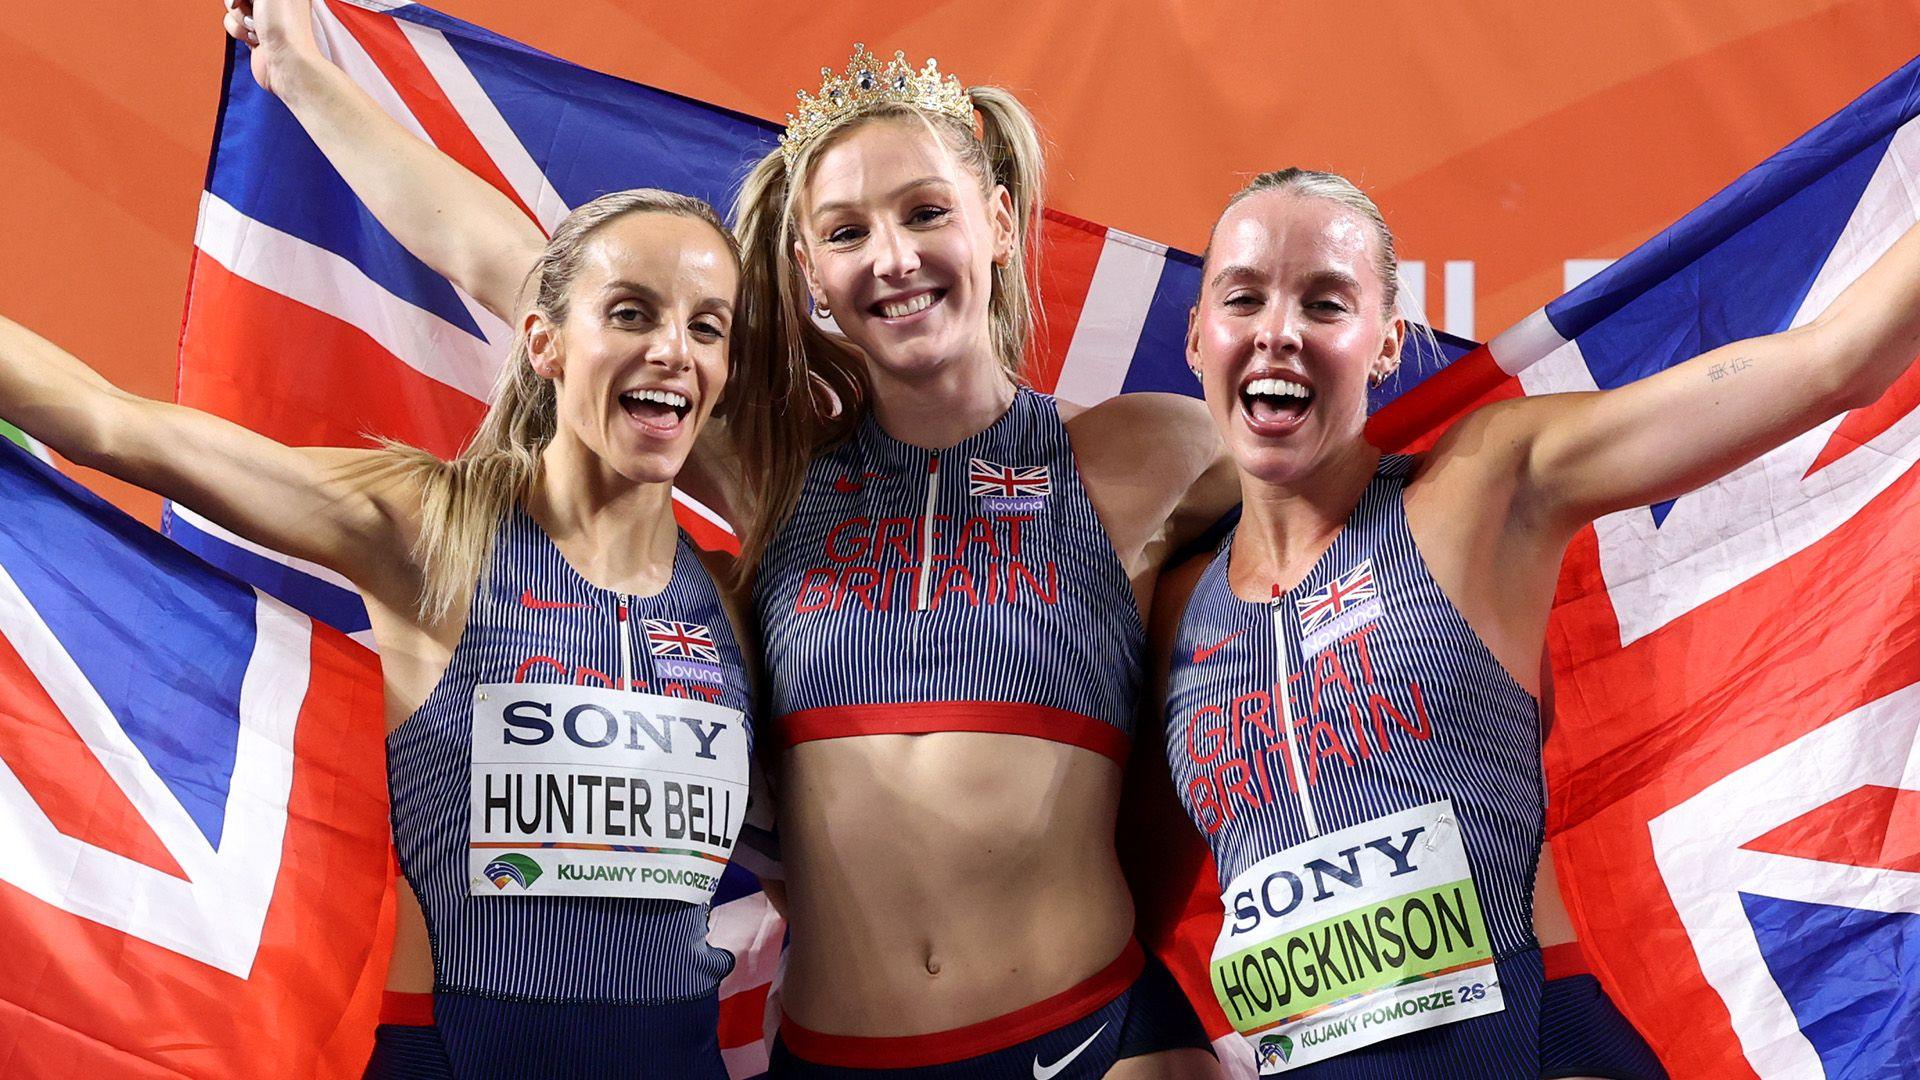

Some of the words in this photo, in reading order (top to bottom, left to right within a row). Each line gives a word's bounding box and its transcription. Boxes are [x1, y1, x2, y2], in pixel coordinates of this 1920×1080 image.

[983, 499, 1043, 511] Novuna
[825, 515, 1033, 564] GREAT
[795, 560, 1057, 614] BRITAIN
[1303, 604, 1380, 660] Novuna
[656, 661, 723, 683] Novuna
[1186, 623, 1378, 765] GREAT
[502, 700, 727, 760] SONY
[1189, 682, 1432, 834] BRITAIN
[485, 773, 652, 837] HUNTER
[664, 780, 733, 850] BELL
[557, 864, 638, 882] KUJAWY
[641, 867, 711, 891] POMORZE
[1230, 826, 1425, 938] SONY
[1219, 887, 1475, 1021] HODGKINSON
[1300, 1016, 1358, 1049] KUJAWY
[1363, 989, 1456, 1029] POMORZE
